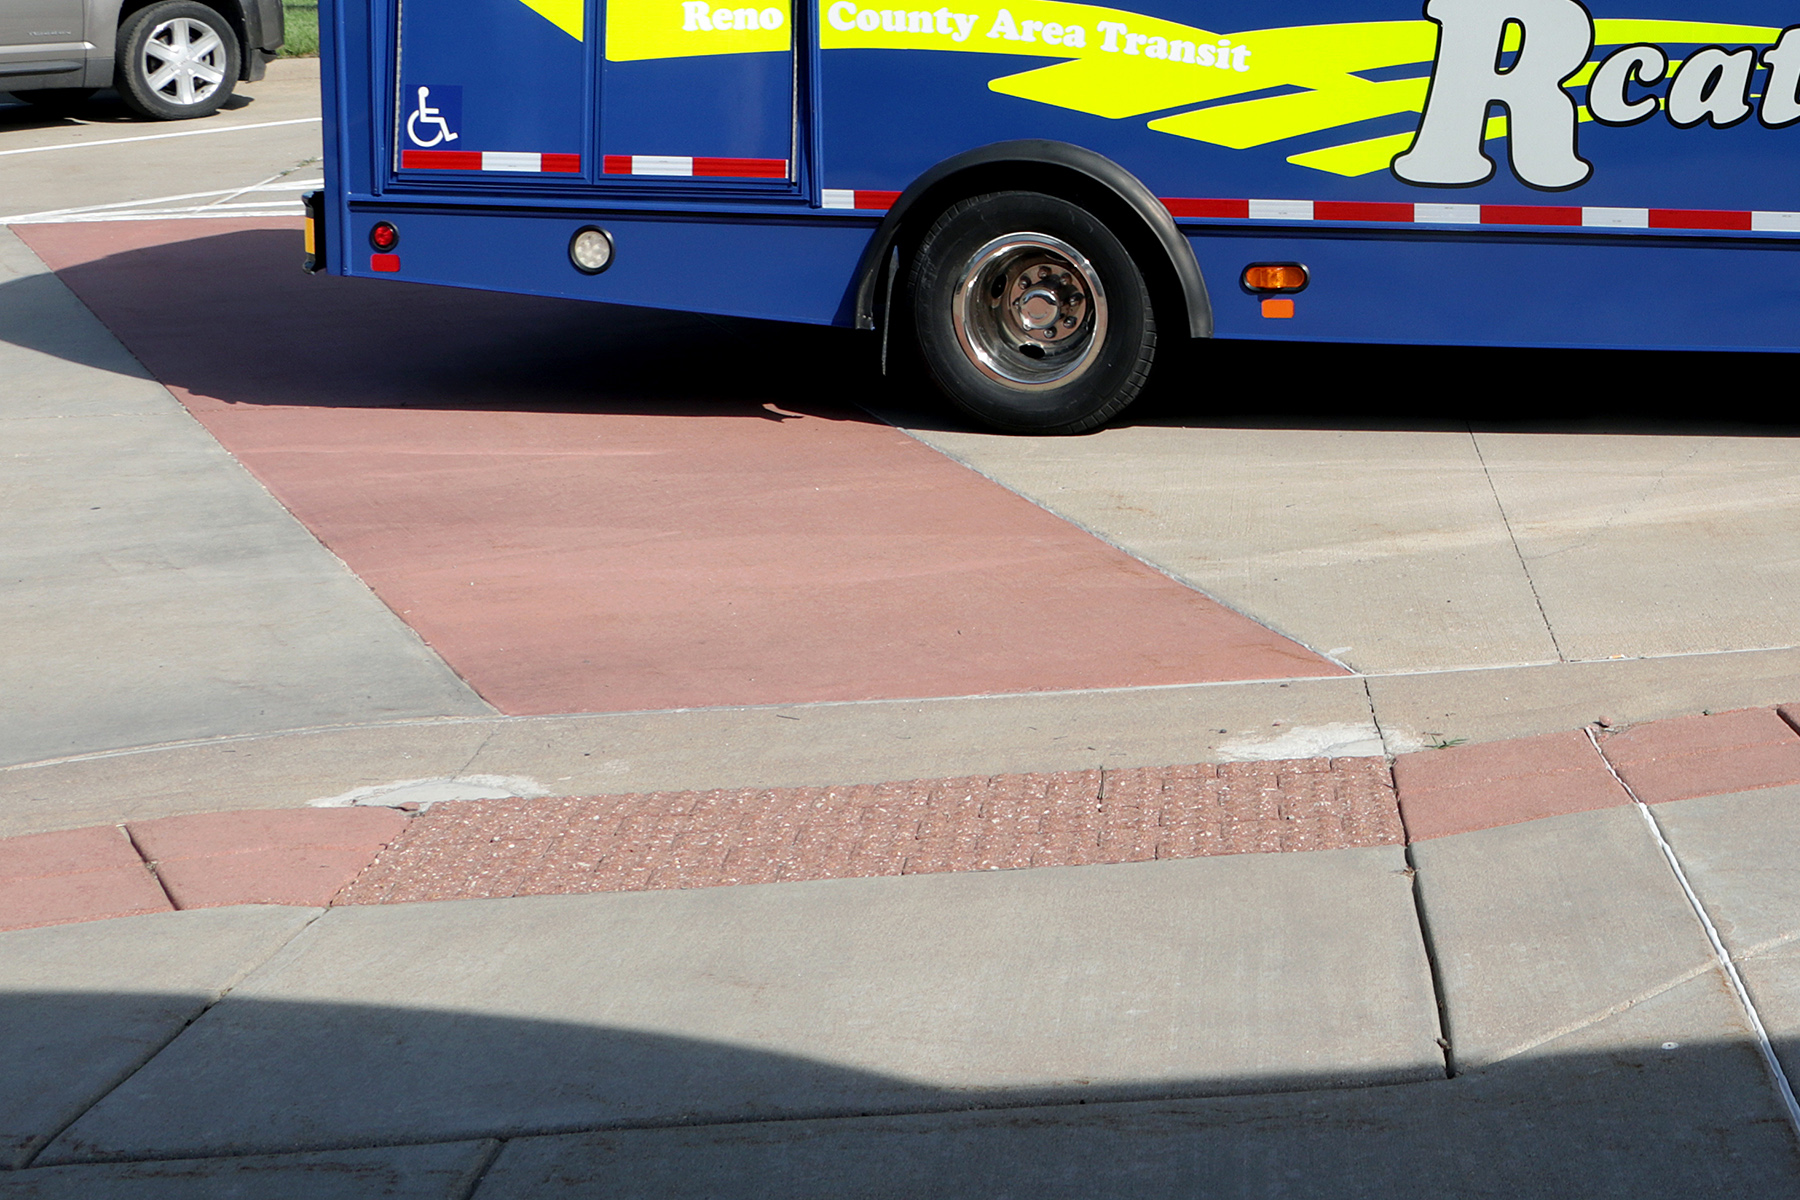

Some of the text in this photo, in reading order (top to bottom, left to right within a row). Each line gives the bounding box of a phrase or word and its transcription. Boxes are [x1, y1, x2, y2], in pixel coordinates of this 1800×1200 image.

[681, 1, 1251, 73] Reno County Area Transit
